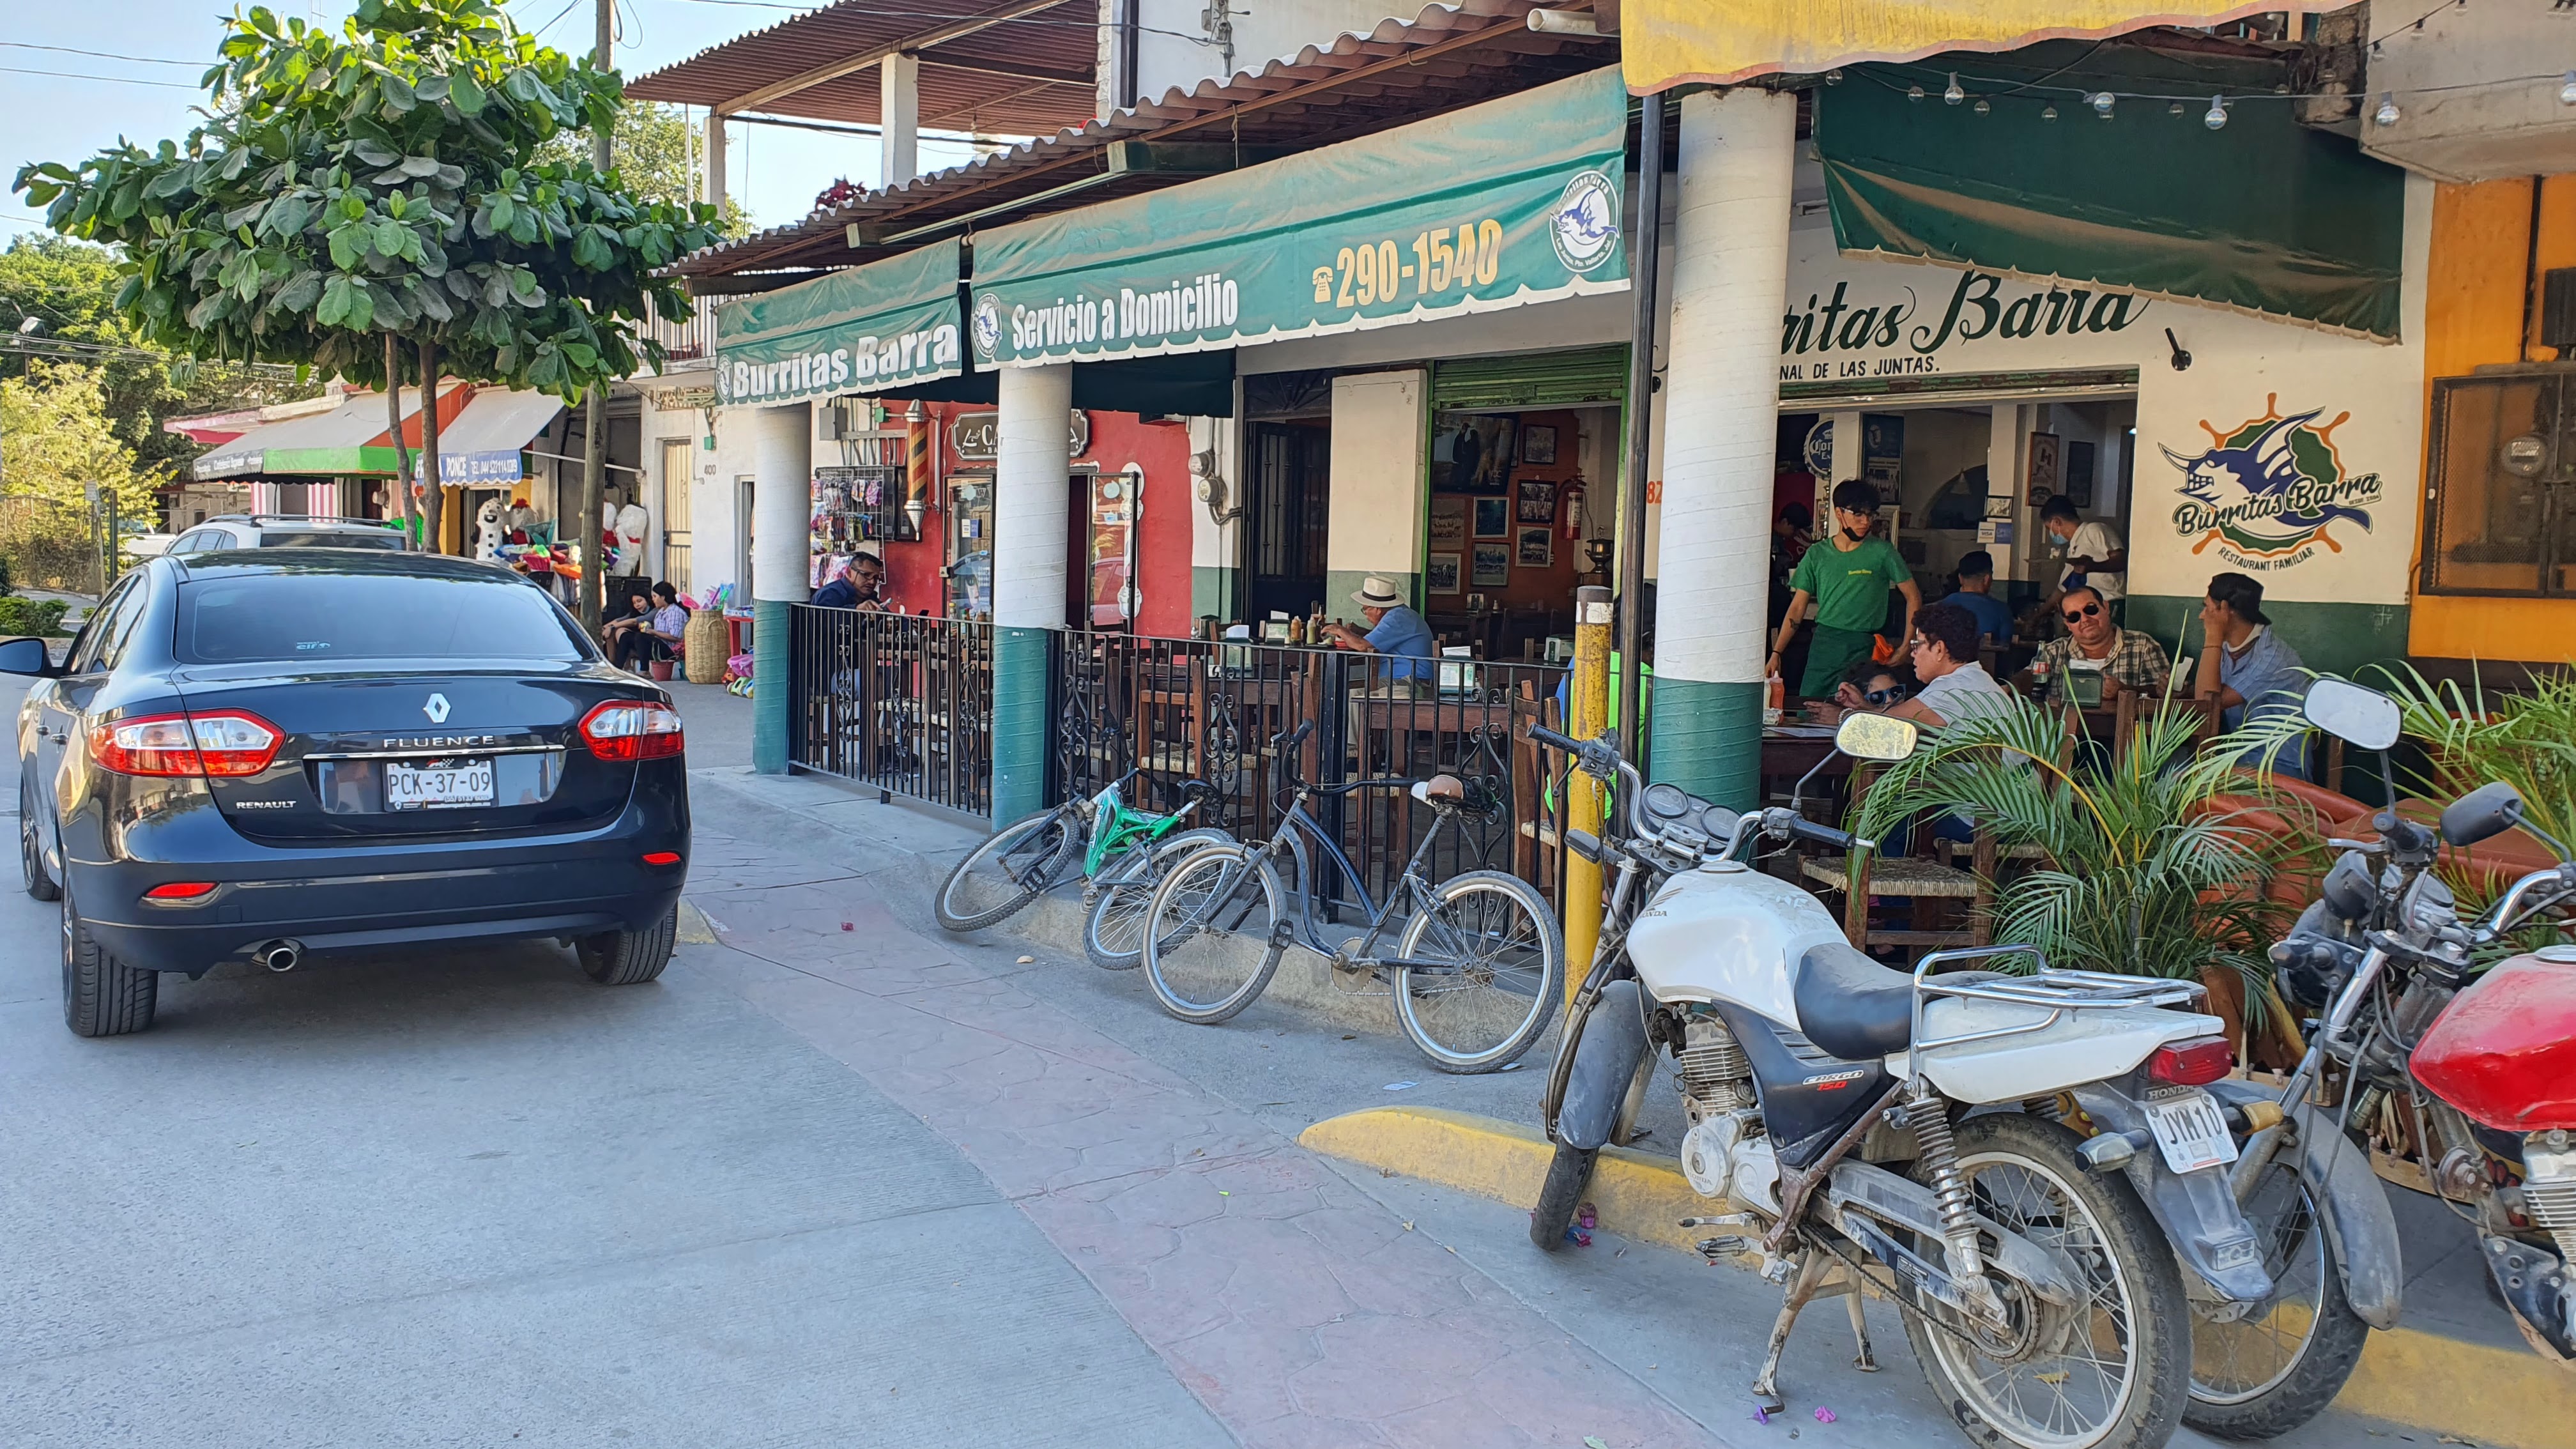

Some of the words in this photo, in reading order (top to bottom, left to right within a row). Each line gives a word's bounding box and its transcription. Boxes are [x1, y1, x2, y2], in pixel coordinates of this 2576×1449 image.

[1336, 218, 1503, 308] 290-1540
[1011, 294, 1097, 351] Servicio
[1101, 297, 1116, 341] a
[1120, 272, 1238, 339] Domicilio
[1782, 281, 1917, 355] ritas
[1910, 268, 2152, 355] Barra
[733, 348, 849, 399] Burritas
[856, 324, 959, 379] Barra
[1779, 365, 1804, 380] NAL
[1813, 362, 1830, 379] DE
[1840, 360, 1867, 377] LAS
[1874, 355, 1940, 376] JUNTAS.
[1809, 438, 1833, 456] Cor
[447, 456, 467, 477] PONCE
[704, 464, 717, 475] 400
[2174, 492, 2283, 534] Burritas
[2288, 474, 2380, 510] Barra
[2218, 546, 2271, 571] RESTAURANT
[2273, 546, 2315, 571] FAMILIAR
[383, 735, 495, 748] FLUENCE
[388, 772, 491, 795] PCK-37-09
[236, 800, 297, 809] RENAULT
[1802, 1070, 1864, 1085] CARGO
[1817, 1080, 1848, 1091] 150
[2149, 1085, 2195, 1100] HONDA
[2163, 1105, 2222, 1145] JYM1D
